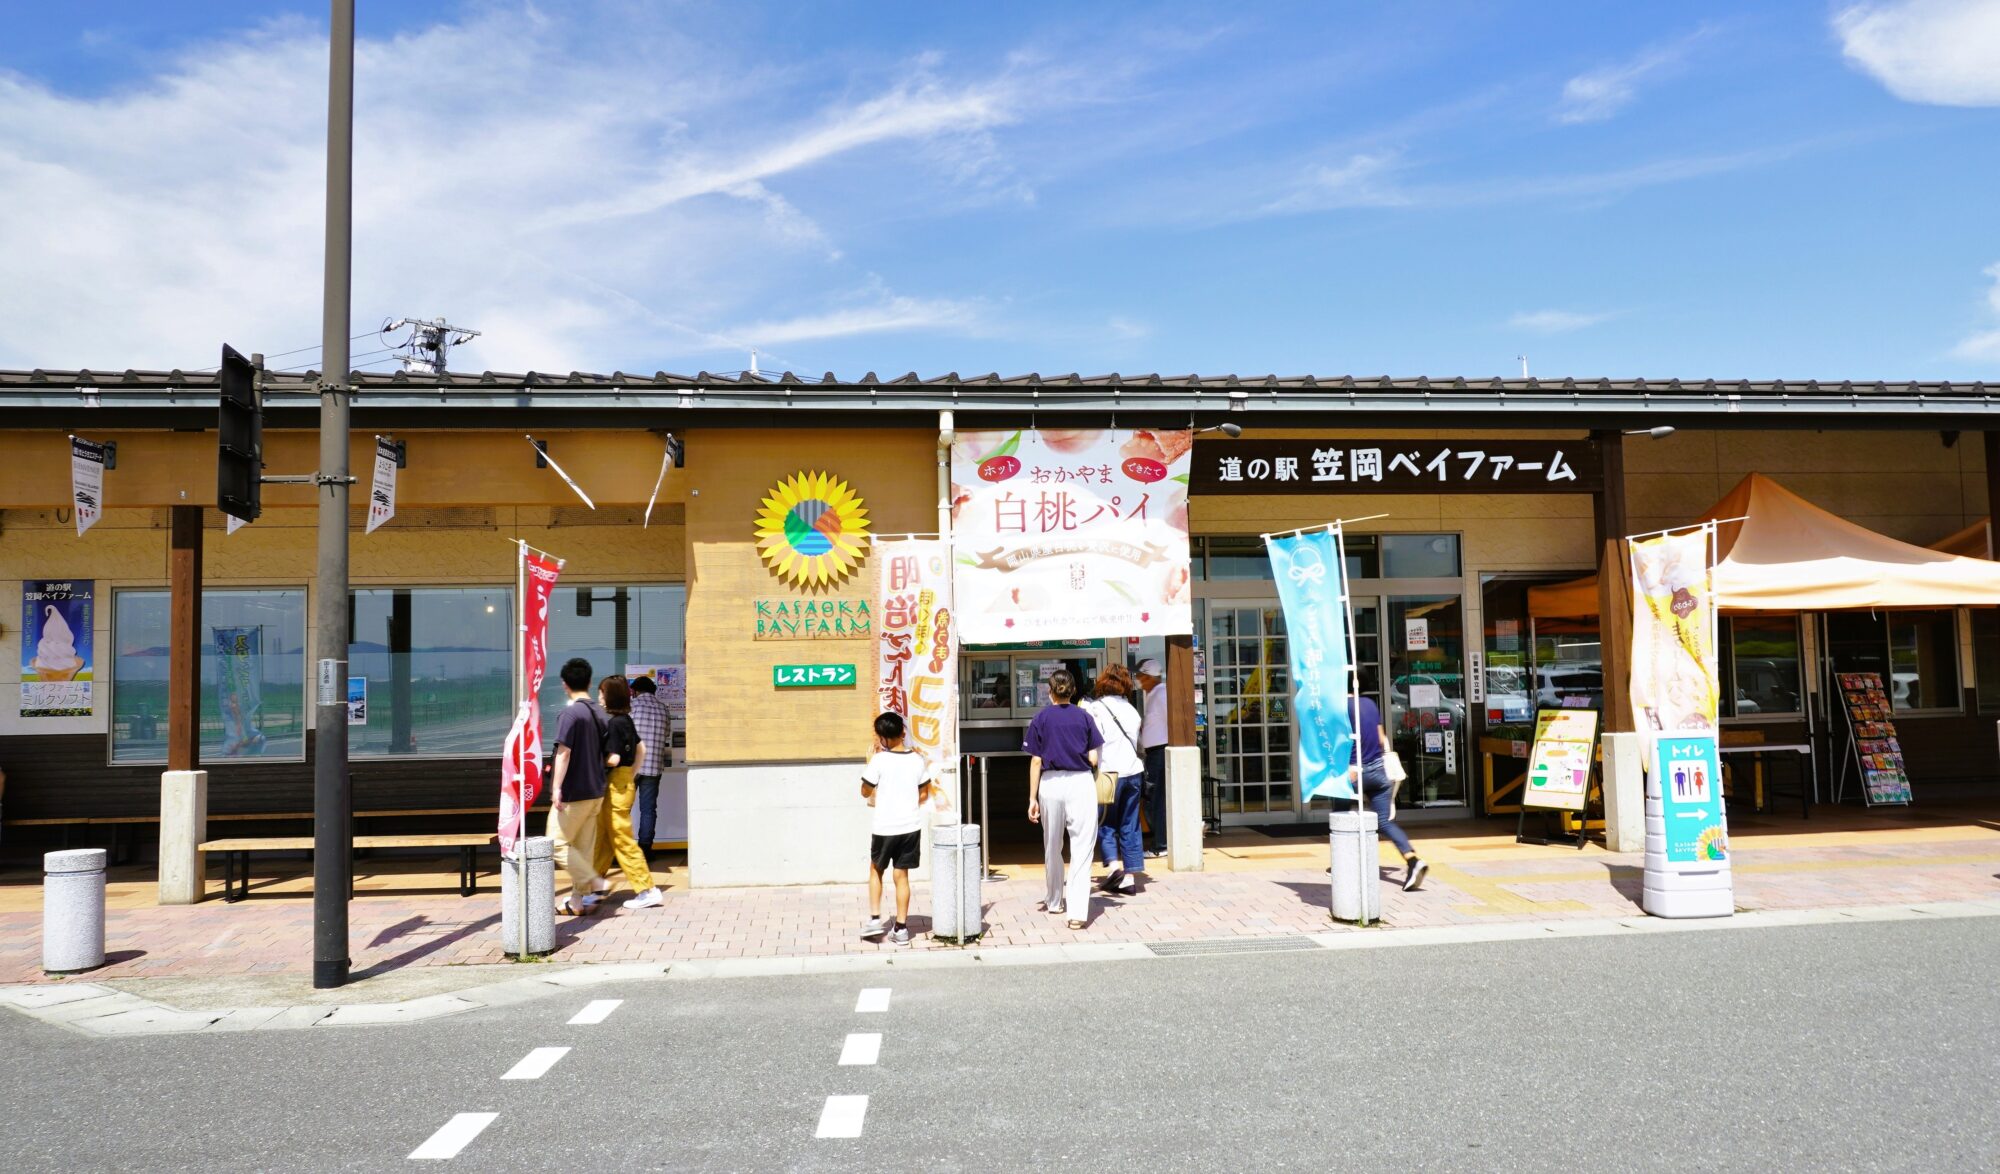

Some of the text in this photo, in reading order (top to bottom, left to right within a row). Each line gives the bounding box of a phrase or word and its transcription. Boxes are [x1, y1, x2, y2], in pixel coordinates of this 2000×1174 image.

[983, 460, 1015, 476] ホット
[1127, 462, 1163, 478] できたて
[1219, 447, 1577, 483] 道の駅 笠岡ベイファーム
[1030, 465, 1114, 485] おかやま
[993, 491, 1151, 534] 白桃パイ
[45, 583, 72, 592] 道の駅
[25, 591, 92, 601] 笠岡ベイファーム
[756, 600, 871, 615] KASAOKA
[756, 618, 871, 633] BAYFARM
[777, 667, 852, 683] レストラン
[31, 683, 83, 693] ベイファーム
[23, 694, 91, 706] ミルクソフト
[1671, 744, 1705, 758] トイレ
